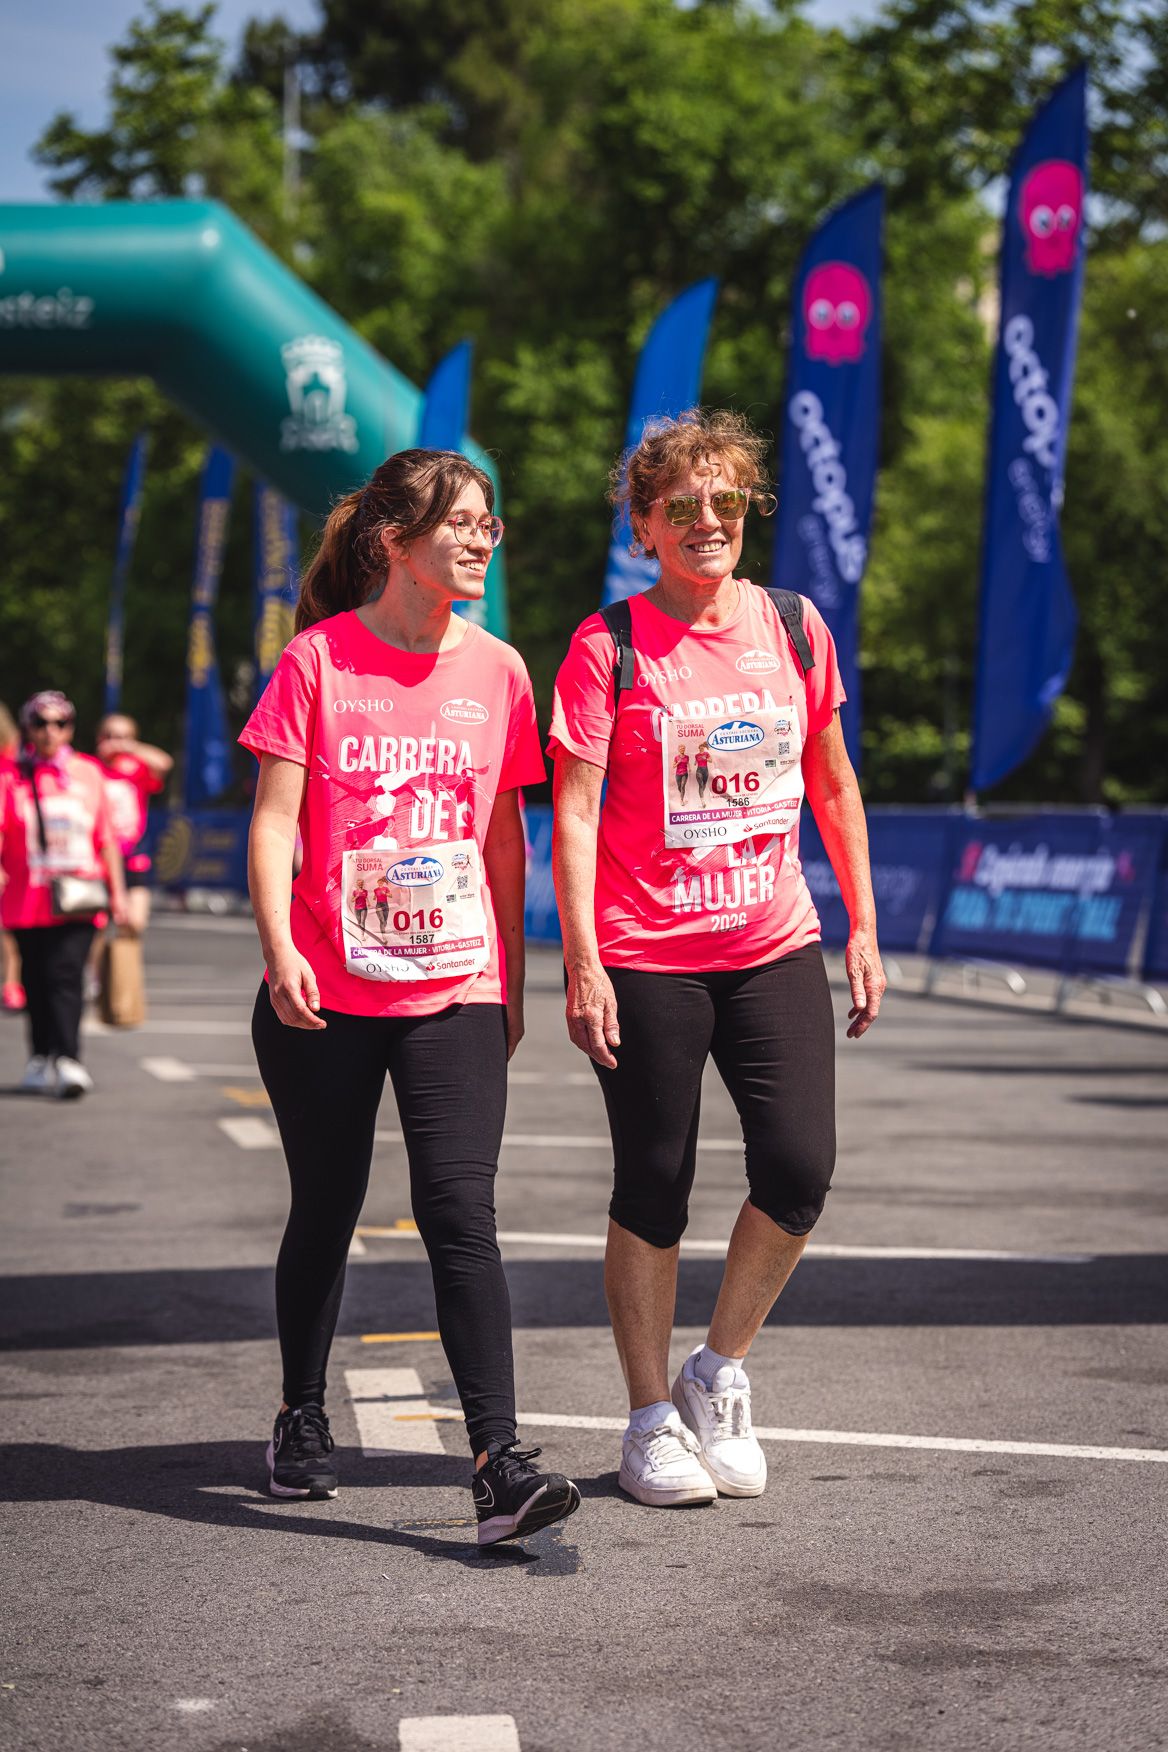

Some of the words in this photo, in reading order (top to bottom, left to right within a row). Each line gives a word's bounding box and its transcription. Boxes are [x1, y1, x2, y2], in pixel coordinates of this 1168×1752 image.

[637, 665, 693, 688] OYSHO
[333, 698, 394, 713] OYSHO
[677, 729, 705, 738] SUMA
[712, 733, 760, 745] ASTURIANA
[338, 735, 474, 777] CARRERA
[711, 771, 760, 795] 016
[726, 797, 750, 808] 1586
[408, 787, 453, 840] DE
[671, 812, 702, 822] CARRERA
[703, 812, 711, 820] DE
[712, 811, 721, 819] LA
[722, 809, 743, 818] MUJER
[683, 826, 727, 839] OYSHO
[753, 817, 790, 830] Santander
[356, 863, 383, 871] SUMA
[672, 865, 776, 912] MUJER
[393, 908, 444, 931] 016
[711, 912, 747, 933] 2026
[409, 934, 435, 945] 1587
[393, 948, 403, 956] LA
[403, 947, 427, 955] MUJER
[437, 958, 475, 970] Santander
